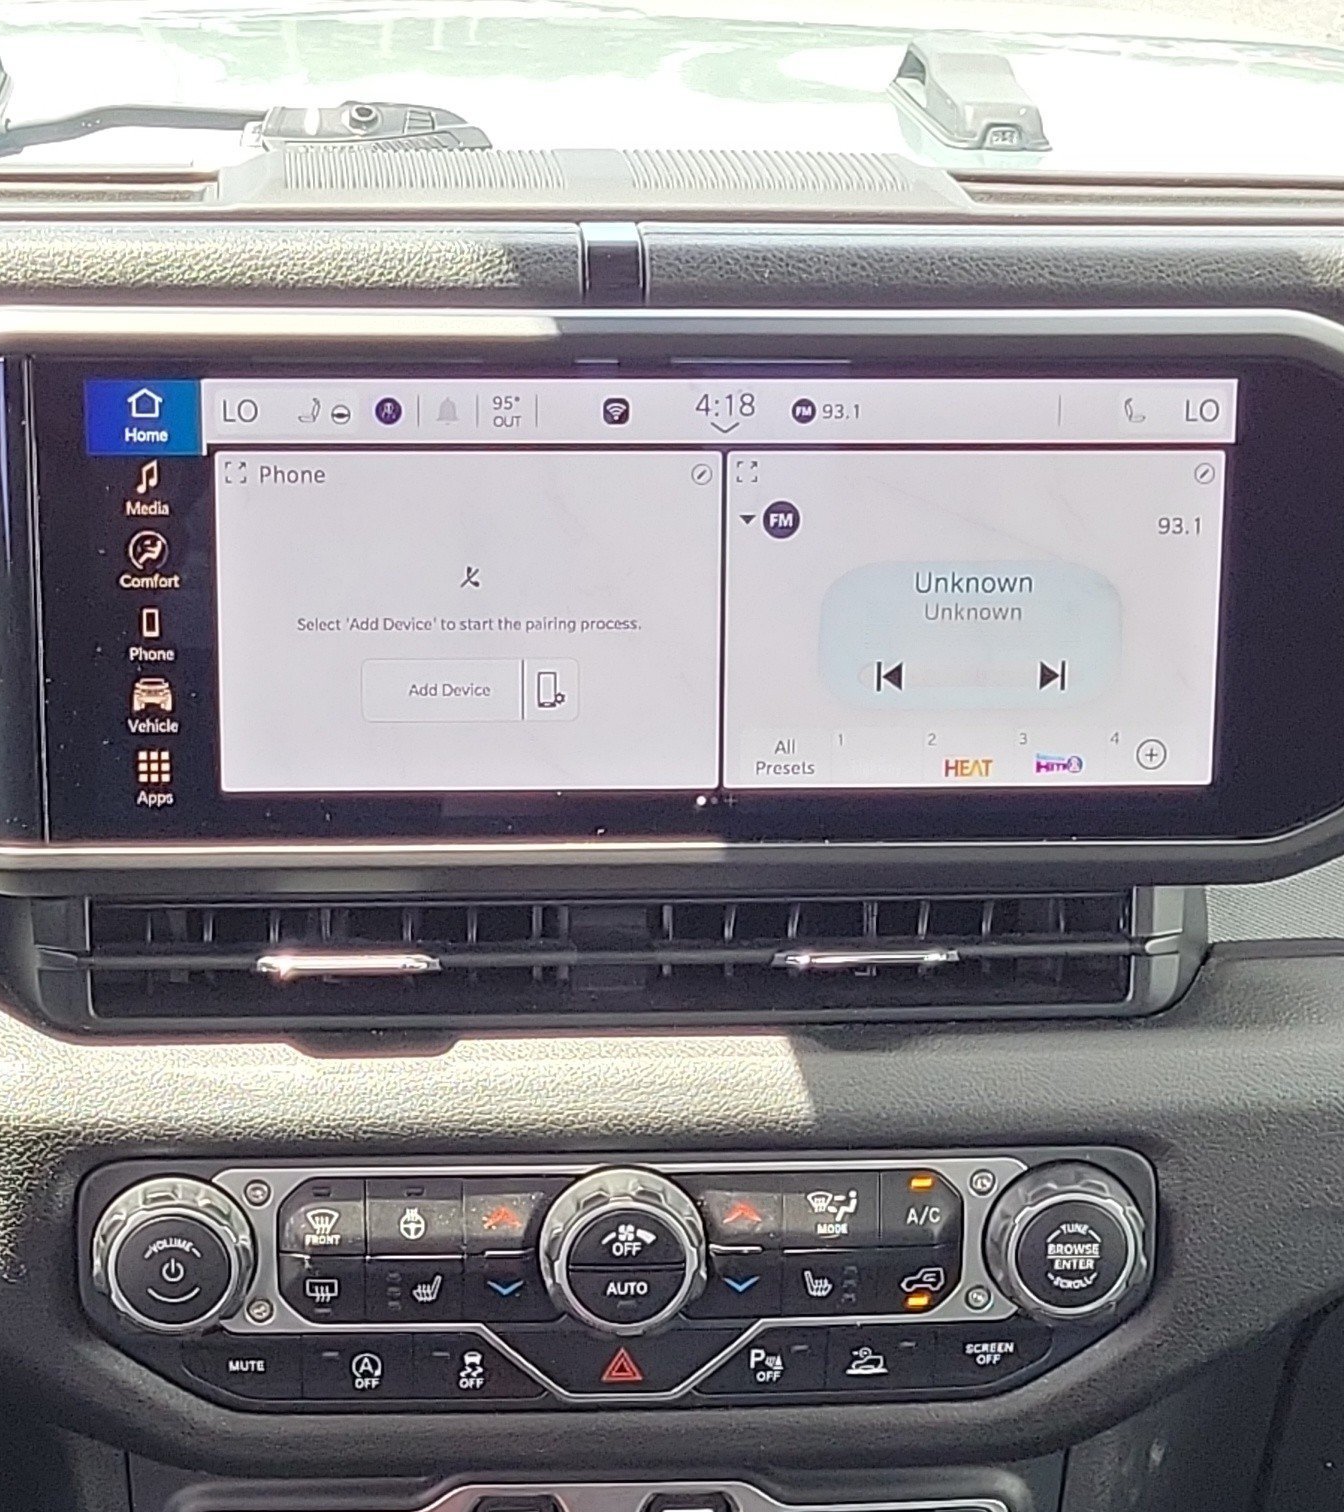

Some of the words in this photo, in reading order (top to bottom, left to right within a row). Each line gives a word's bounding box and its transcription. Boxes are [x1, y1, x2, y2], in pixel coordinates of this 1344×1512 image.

[222, 399, 258, 423] LO
[695, 393, 756, 417] 4:18
[794, 405, 814, 418] FM
[822, 404, 861, 420] 93.1
[1185, 399, 1220, 422] LO
[493, 416, 522, 428] OUT
[125, 427, 168, 443] Home
[260, 464, 326, 485] Phone
[126, 500, 169, 516] Media
[770, 513, 794, 529] FM
[1157, 517, 1202, 536] 93.1
[119, 574, 180, 589] Comfort
[914, 572, 1034, 594] Unknown
[924, 603, 1023, 622] Unknown
[297, 618, 341, 631] Select
[346, 617, 379, 631] 'Add
[383, 617, 437, 631] Device'
[441, 619, 456, 631] to
[459, 619, 494, 631] start
[498, 618, 521, 631] the
[525, 618, 576, 635] pairing
[581, 619, 642, 635] process.
[129, 647, 175, 662] Phone
[409, 683, 438, 697] Add
[442, 683, 490, 697] Device
[128, 718, 179, 733] Vehicle
[927, 733, 937, 746] 2
[1018, 733, 1027, 745] 3
[1110, 732, 1120, 744] 4
[774, 739, 795, 755] All
[756, 760, 815, 776] Presets
[945, 758, 993, 777] HEAT
[137, 791, 173, 807] Apps
[906, 1206, 941, 1225] A/C
[817, 1223, 848, 1234] MODE
[1060, 1223, 1089, 1235] TUNE
[148, 1237, 193, 1252] VOLUME
[305, 1234, 341, 1245] FRONT
[612, 1242, 641, 1256] OFF
[1047, 1243, 1100, 1255] BROWSE
[1054, 1259, 1095, 1270] ENTER
[606, 1281, 648, 1296] AUTO
[965, 1342, 1014, 1354] SCREEN
[228, 1360, 265, 1372] MUTE
[976, 1354, 1000, 1365] OFF
[355, 1378, 380, 1389] OFF
[459, 1378, 484, 1389] OFF
[756, 1371, 780, 1382] OFF
